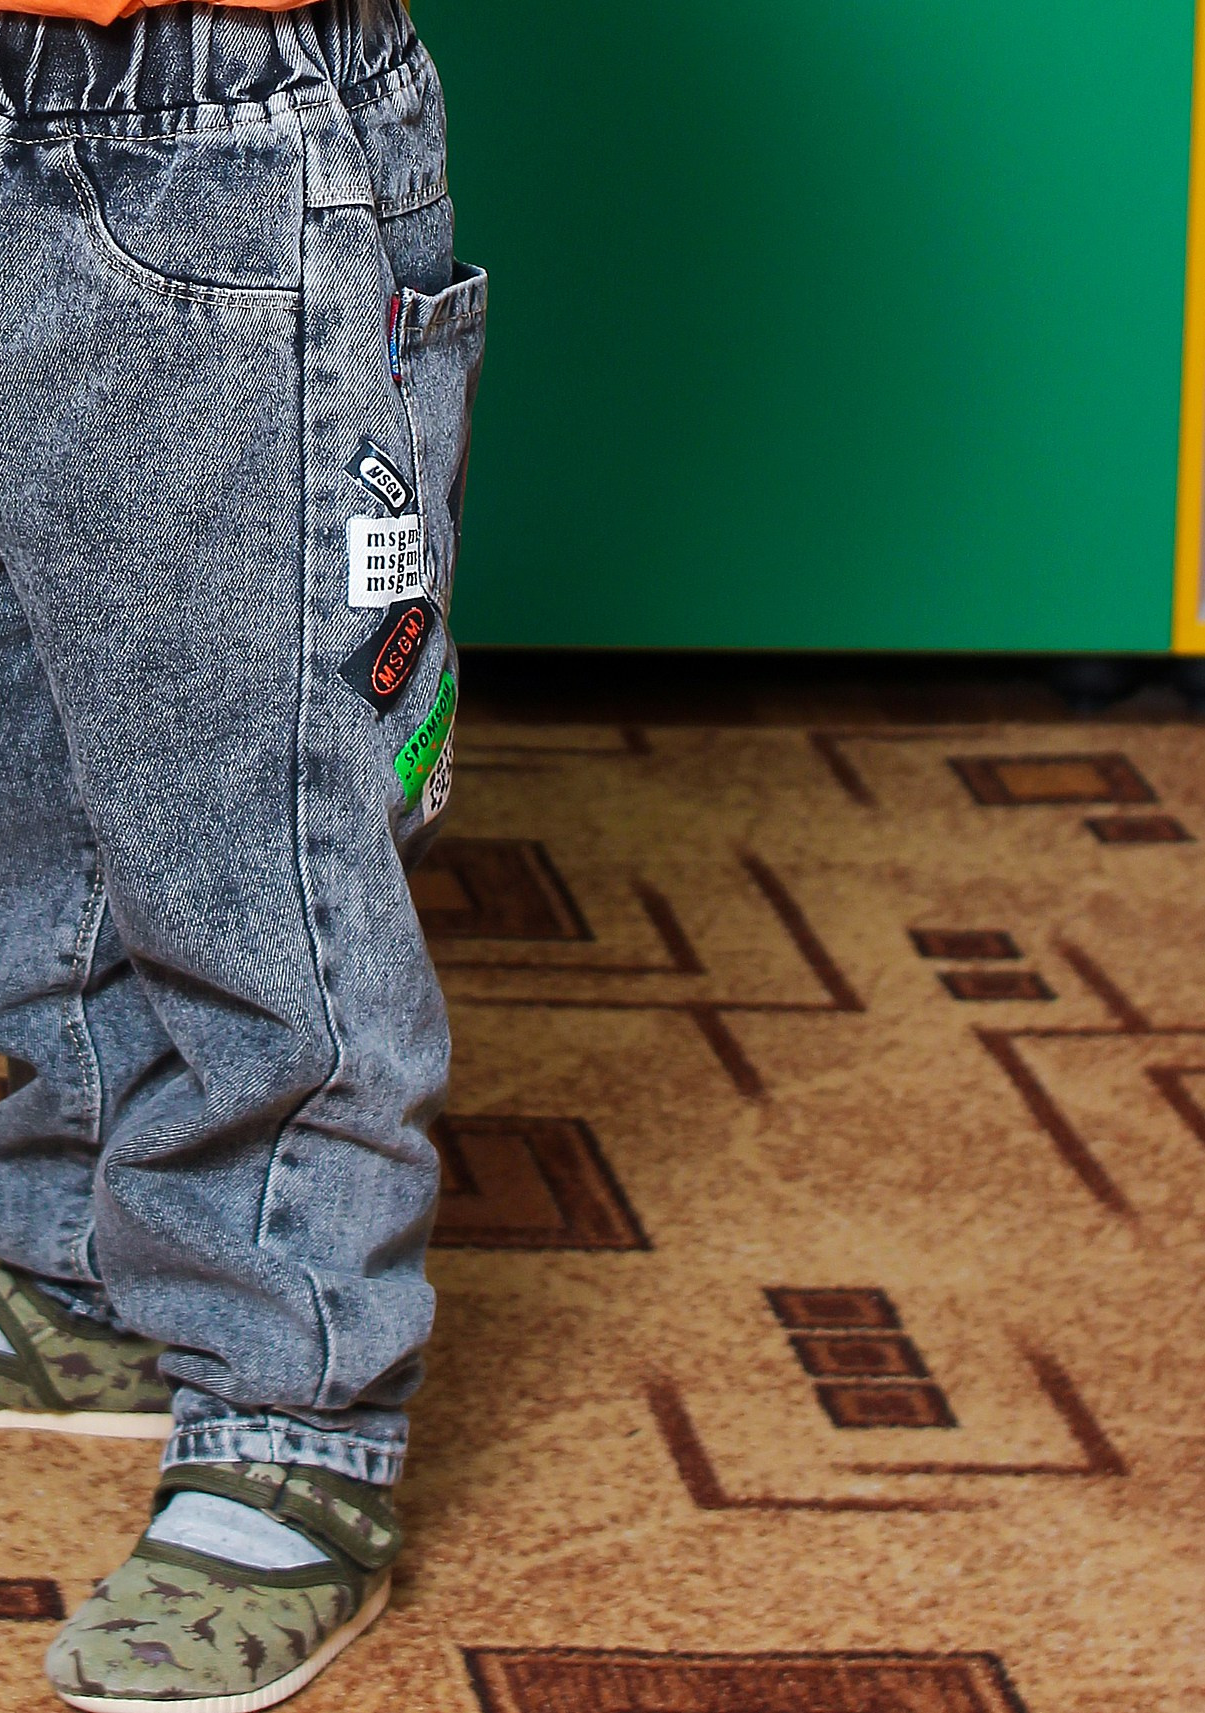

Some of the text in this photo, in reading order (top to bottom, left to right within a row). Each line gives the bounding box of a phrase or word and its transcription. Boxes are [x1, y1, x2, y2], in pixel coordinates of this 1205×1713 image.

[367, 529, 419, 551] msgm
[367, 550, 418, 574] msgm
[366, 571, 418, 594] msgm
[377, 617, 421, 688] MSGM
